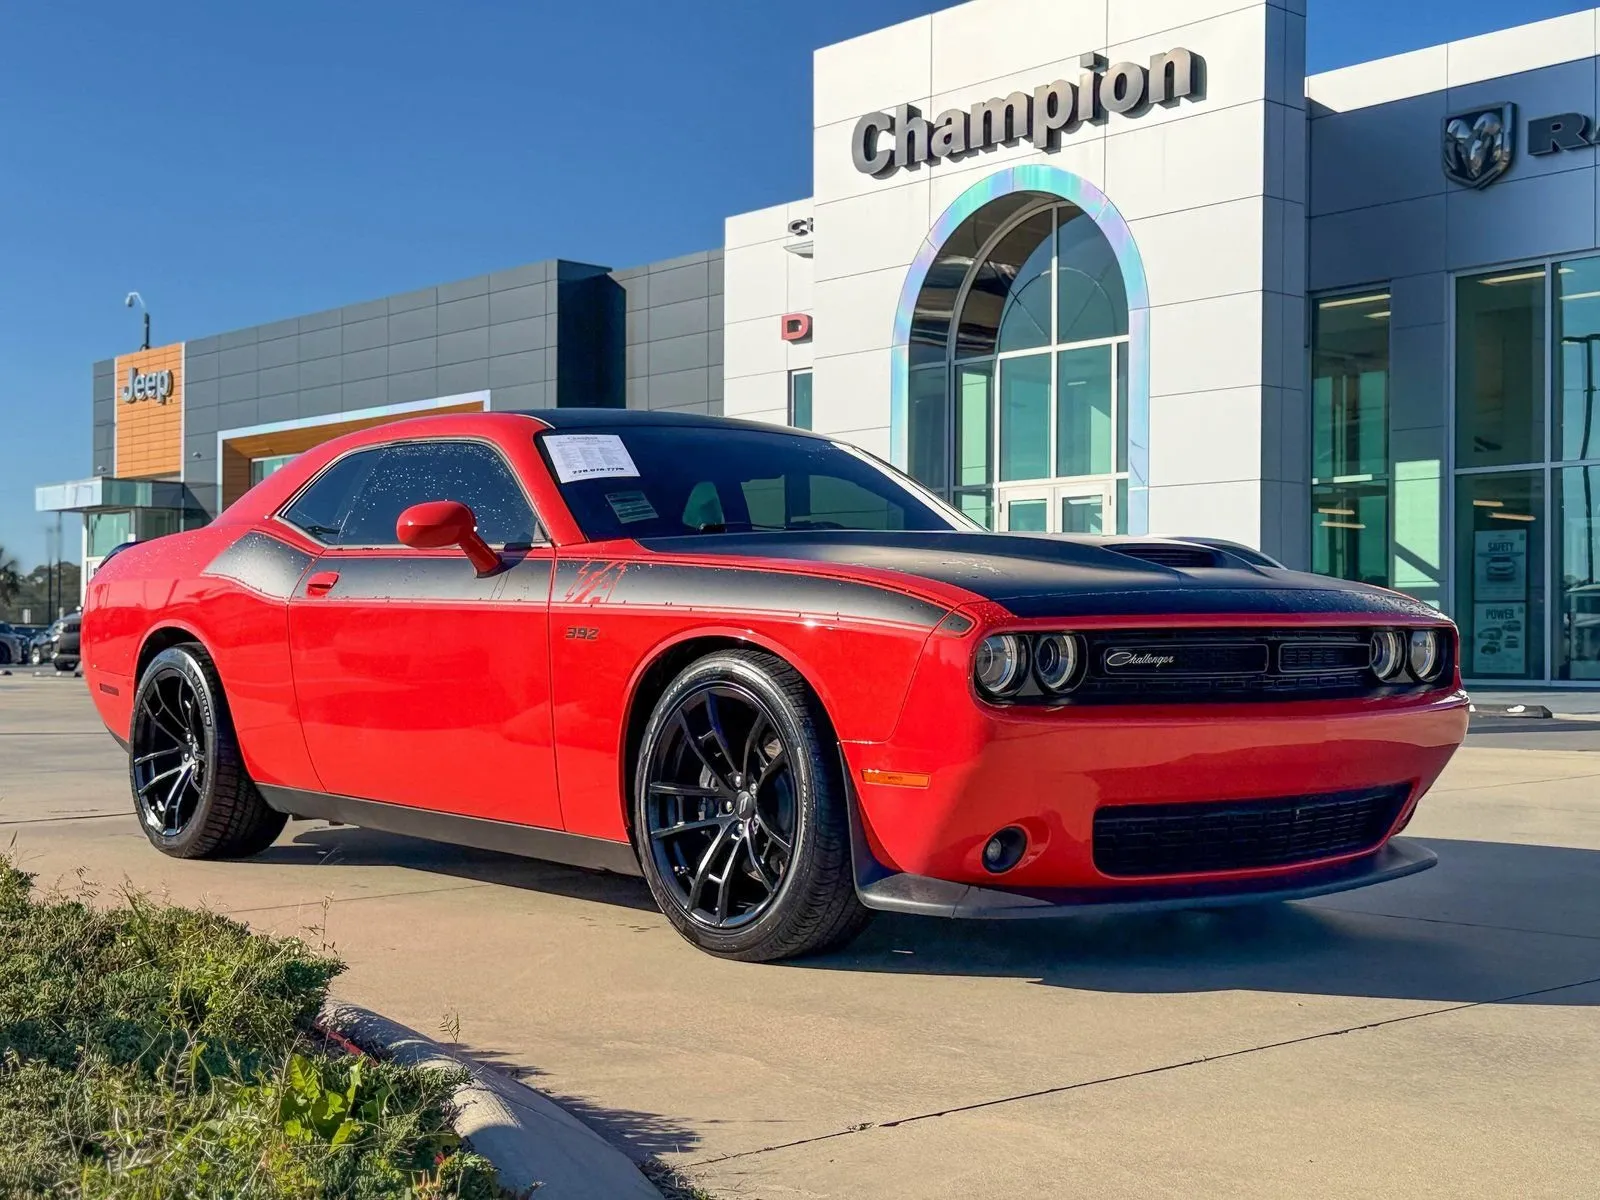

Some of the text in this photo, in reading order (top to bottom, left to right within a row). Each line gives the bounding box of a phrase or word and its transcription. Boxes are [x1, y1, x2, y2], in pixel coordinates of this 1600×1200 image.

[851, 46, 1208, 179] Champion
[1528, 112, 1600, 156] R
[122, 367, 174, 405] Jeep
[1488, 542, 1515, 552] SAFETY
[1485, 608, 1515, 619] POWER
[565, 627, 599, 640] 392
[1107, 651, 1174, 668] Challenger
